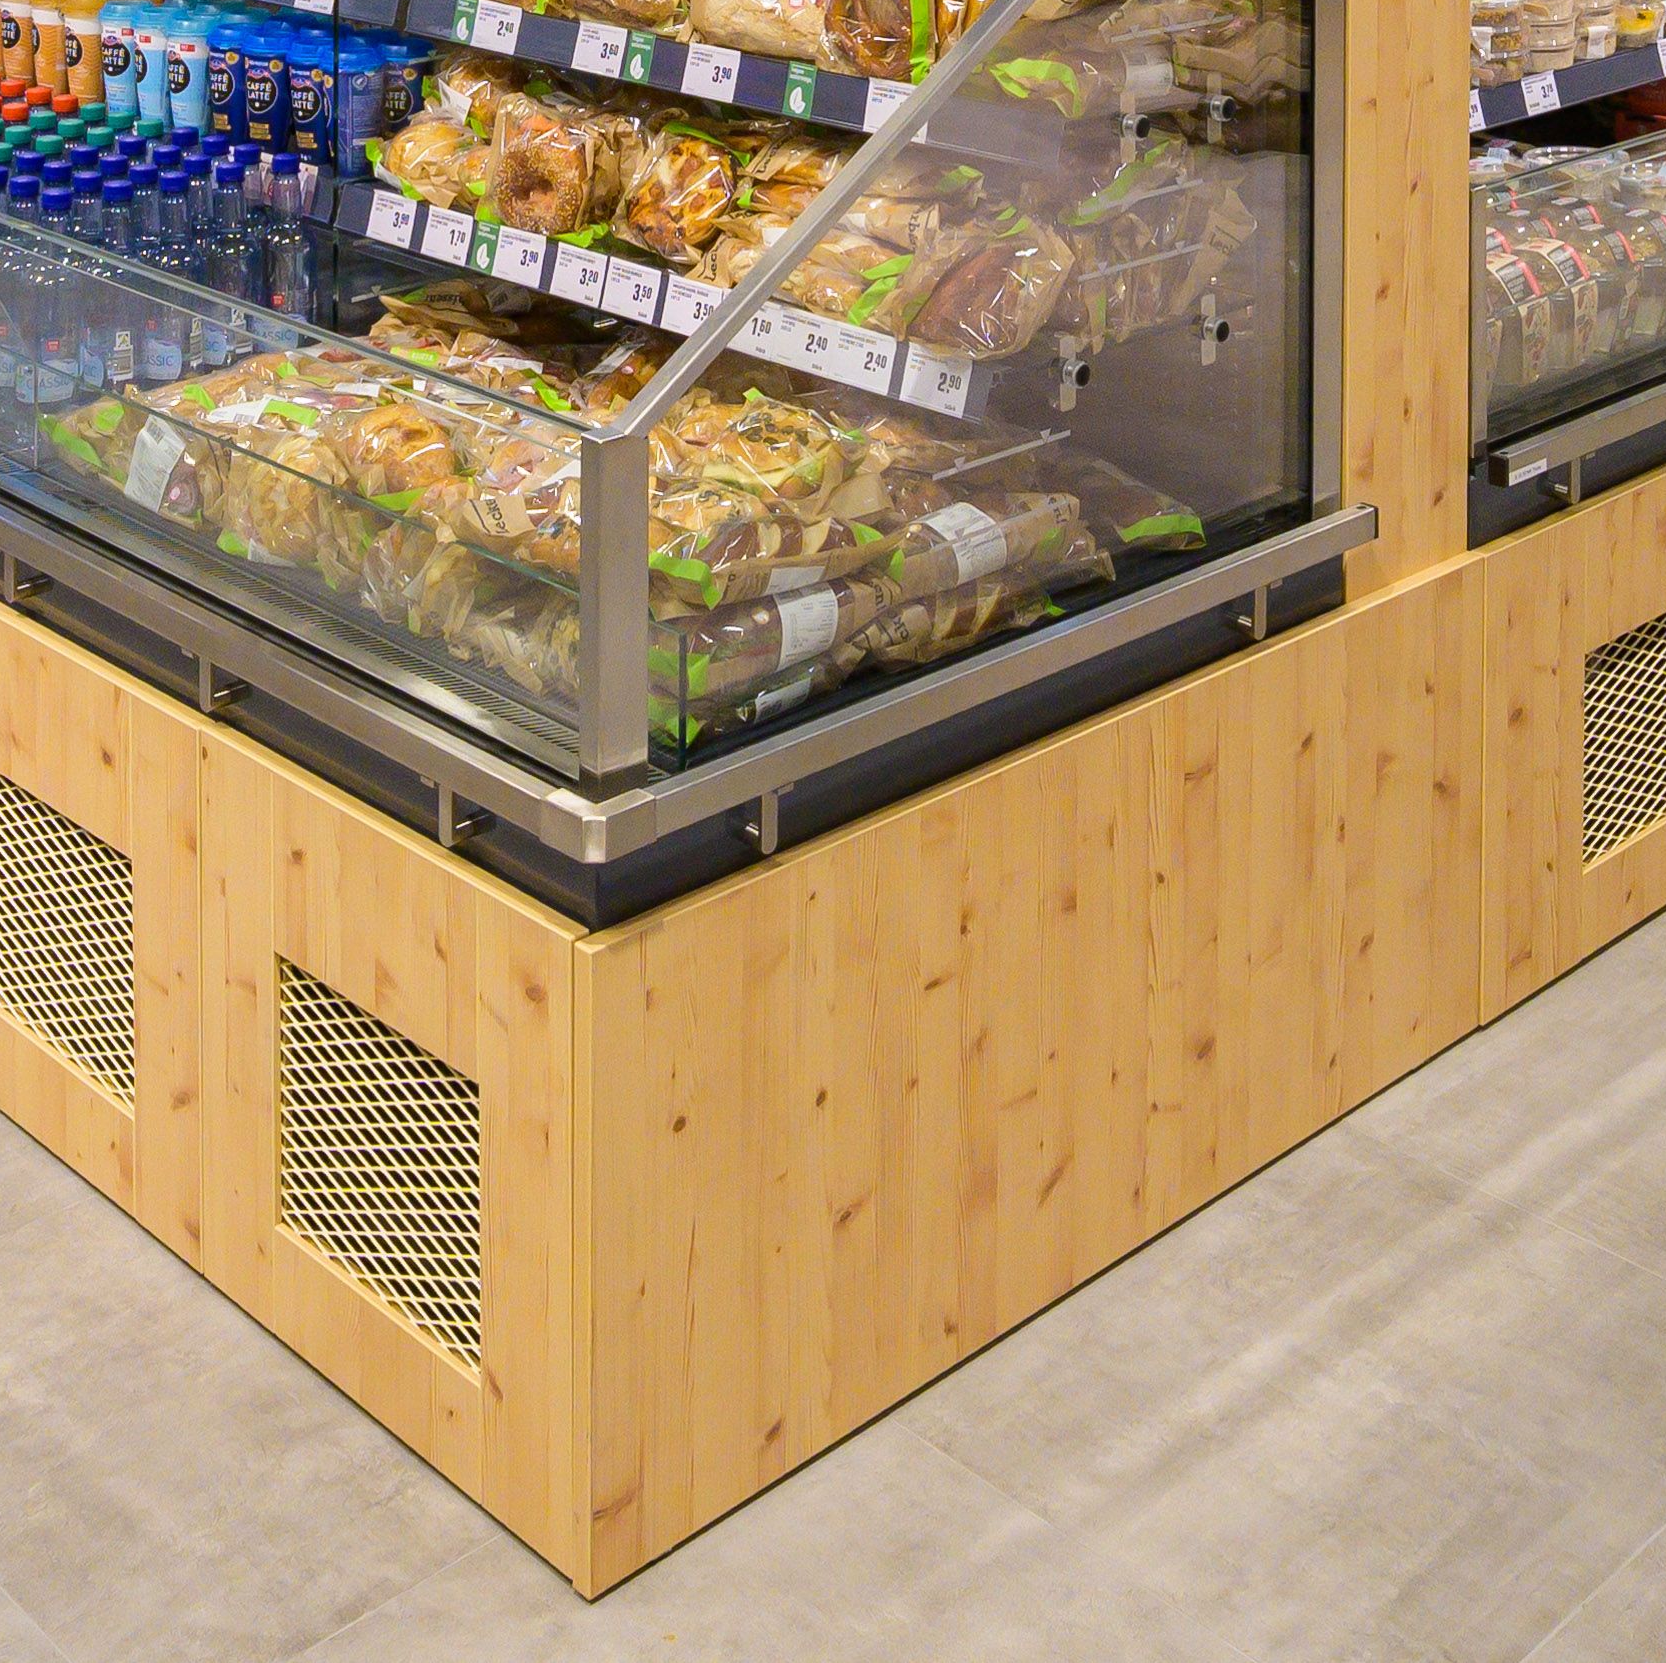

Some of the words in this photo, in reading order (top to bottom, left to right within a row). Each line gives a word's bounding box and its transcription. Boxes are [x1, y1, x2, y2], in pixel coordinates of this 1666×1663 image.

[496, 19, 515, 38] 2.40
[711, 64, 733, 84] 3.90
[246, 90, 271, 102] LATTE
[520, 248, 540, 268] 3.90
[579, 267, 599, 288] 3.20
[633, 283, 653, 304] 3.50
[751, 316, 772, 338] 1.60
[805, 333, 829, 355] 2.40
[864, 351, 888, 373] 2.40
[937, 371, 962, 394] 2.90
